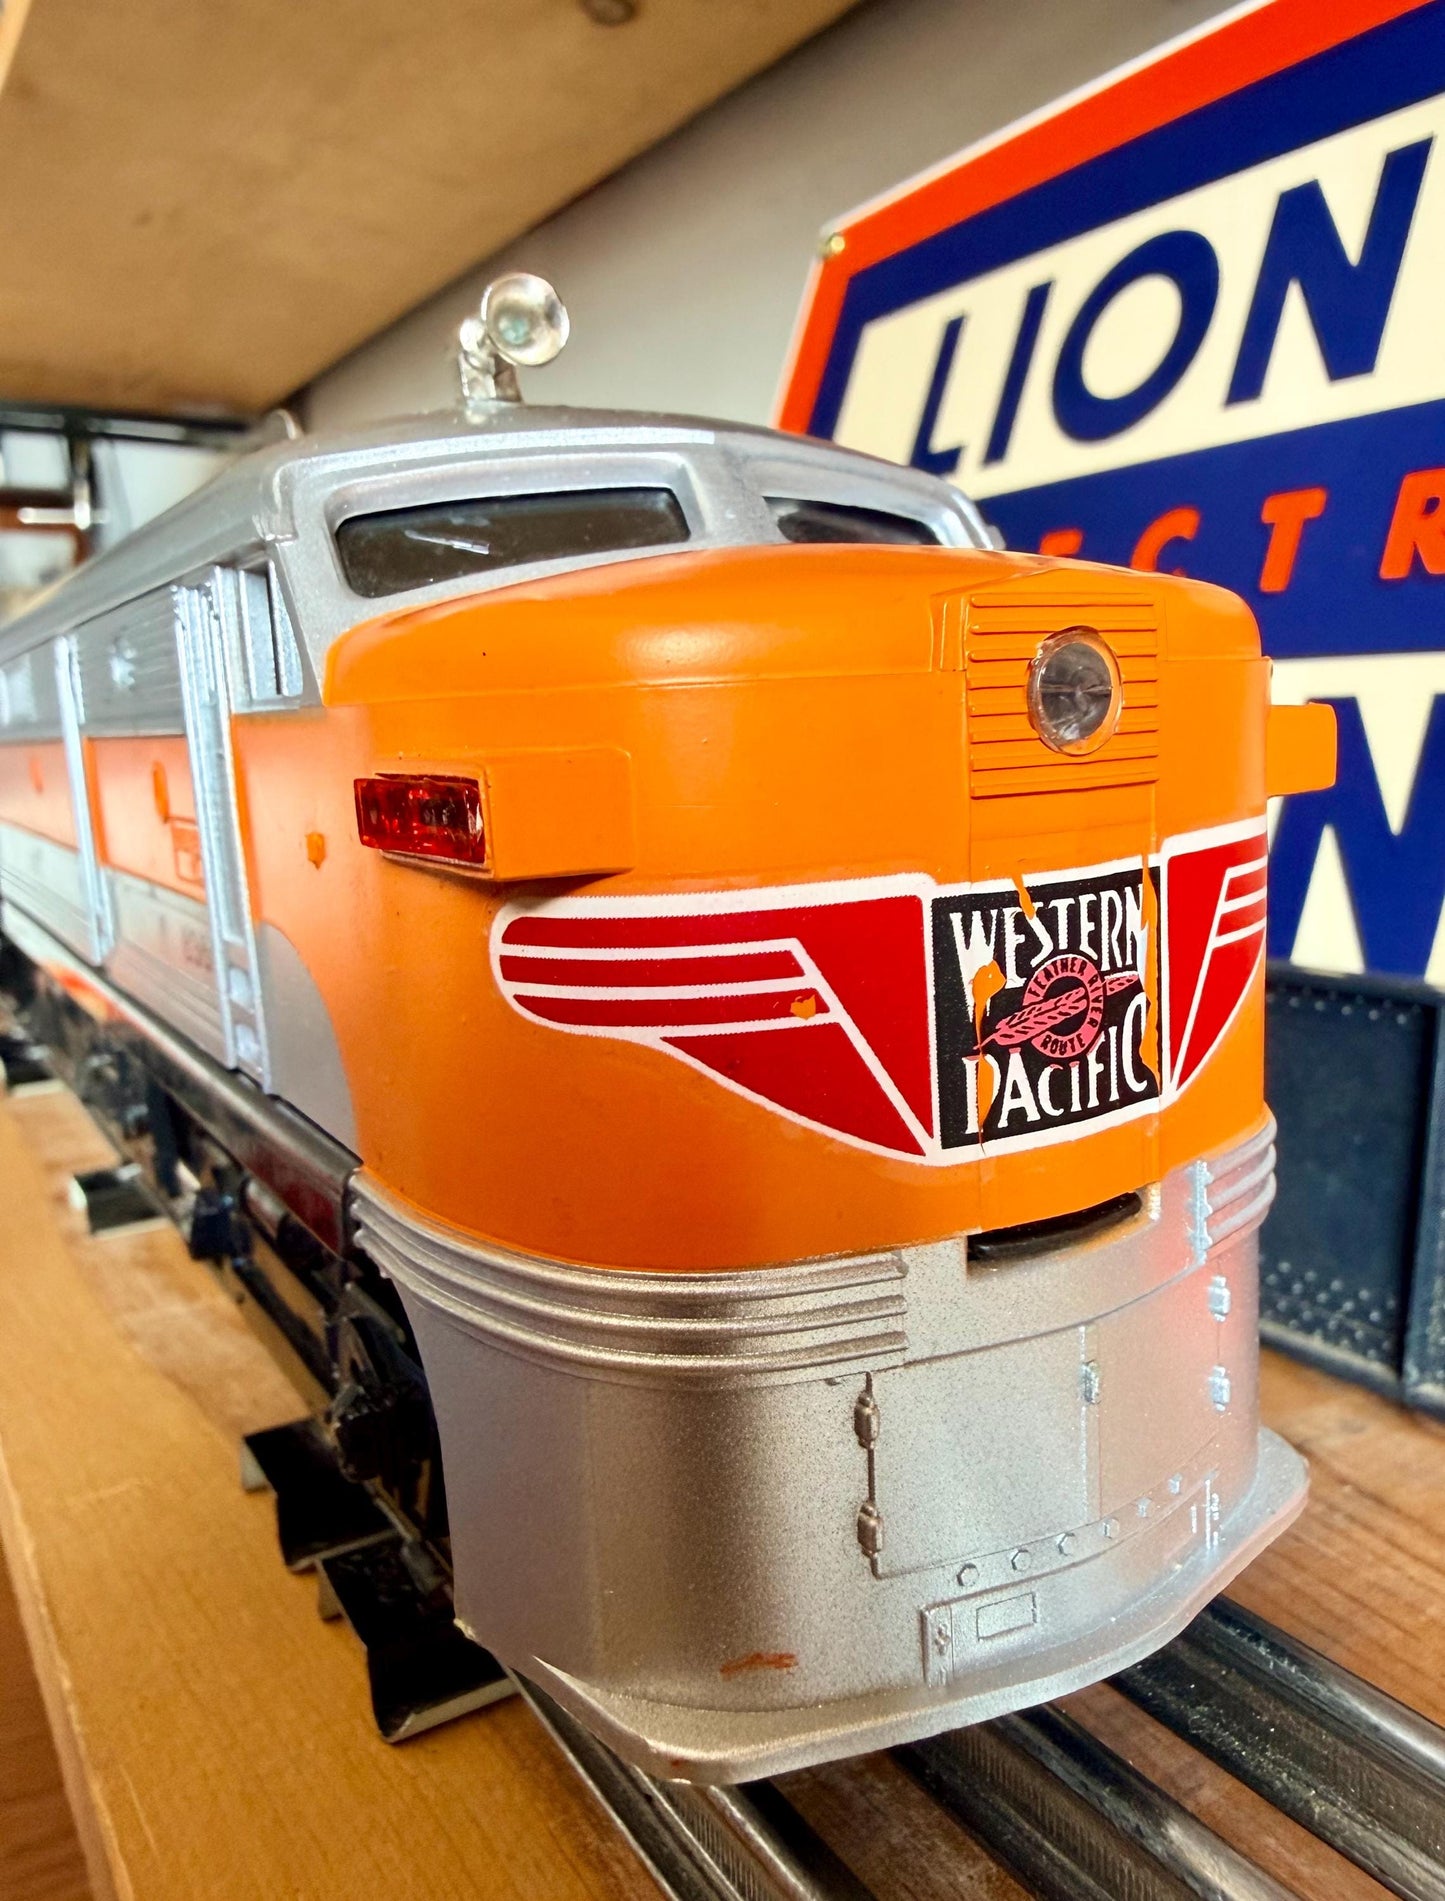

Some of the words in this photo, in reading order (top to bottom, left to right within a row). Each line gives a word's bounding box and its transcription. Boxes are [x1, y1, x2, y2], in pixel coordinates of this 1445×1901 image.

[907, 134, 1436, 478] LION
[949, 884, 1149, 1023] WESTERN
[1027, 956, 1088, 998] FEATHER
[1086, 973, 1104, 1029] RIVER
[962, 991, 1148, 1134] PACIFIC
[1040, 1032, 1087, 1056] ROUTE
